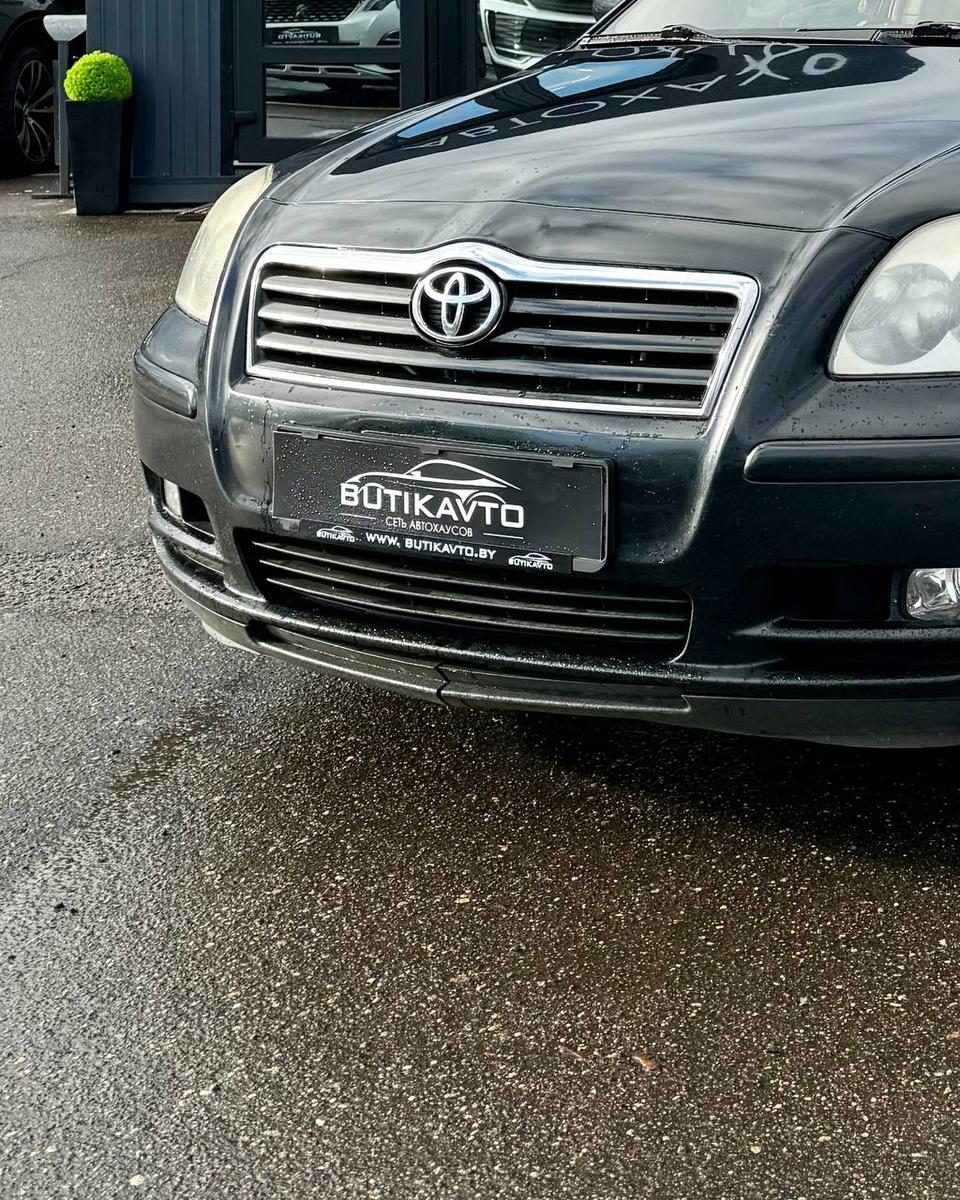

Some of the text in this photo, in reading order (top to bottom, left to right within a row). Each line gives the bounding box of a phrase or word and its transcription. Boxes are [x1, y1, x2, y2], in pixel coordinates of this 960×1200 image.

[340, 482, 524, 529] BUTIKAVTO
[316, 530, 356, 543] BUTIKAVTO
[385, 516, 473, 538] СЕТЬ АВТОХАУСОВ
[405, 538, 496, 560] BUTIKAVTO.BY
[508, 557, 553, 571] BUTIKAVTO
